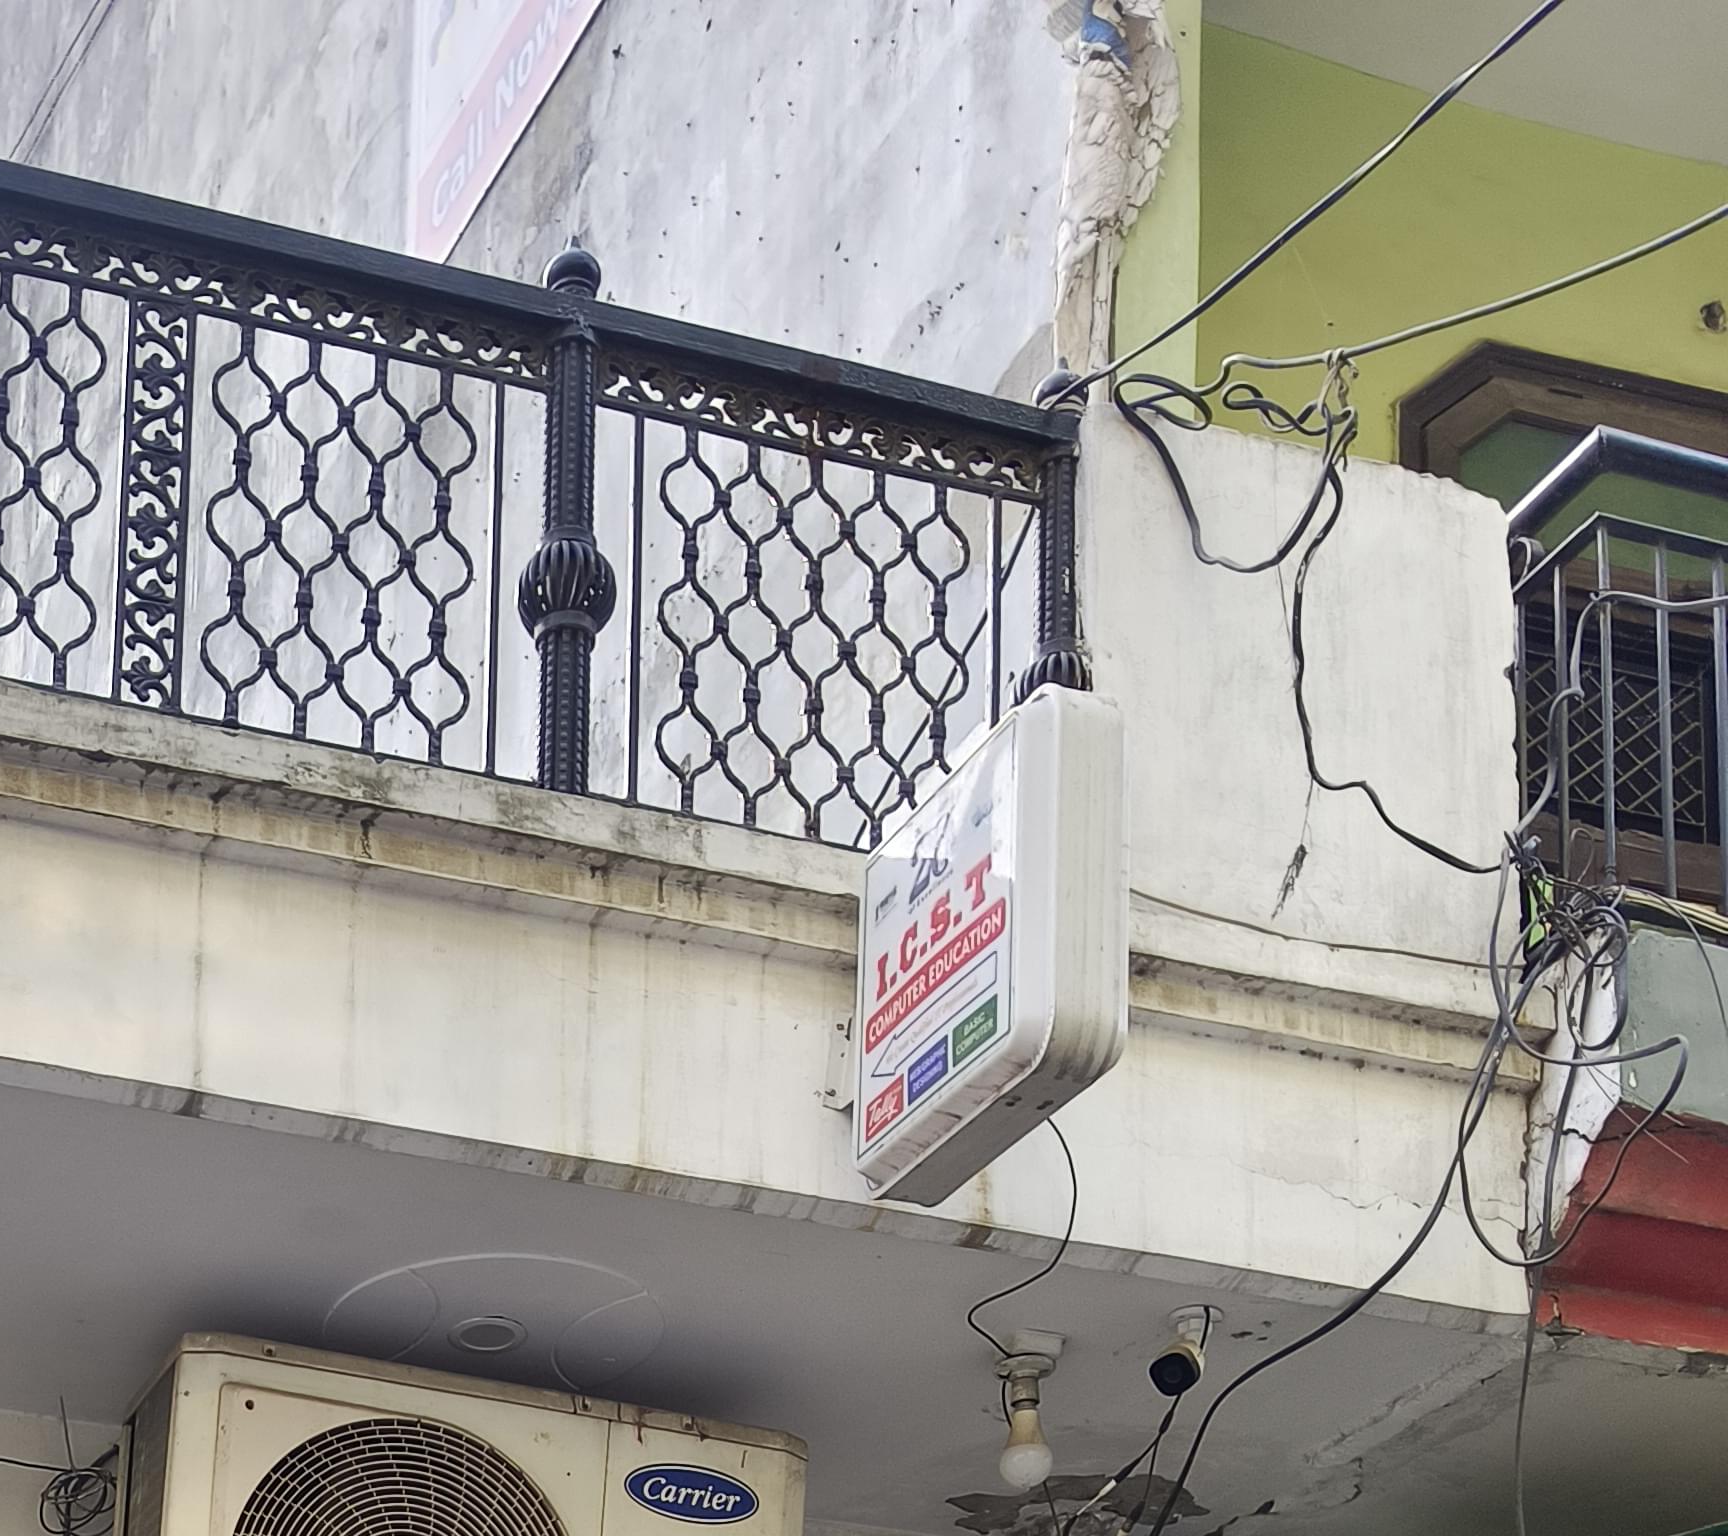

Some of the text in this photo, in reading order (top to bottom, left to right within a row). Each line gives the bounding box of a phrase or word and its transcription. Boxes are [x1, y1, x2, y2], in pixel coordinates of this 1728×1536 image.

[432, 112, 486, 228] Call
[868, 974, 926, 1042] COMPUTER
[928, 907, 1002, 987] EDUCATION
[643, 1476, 741, 1512] Carrier
